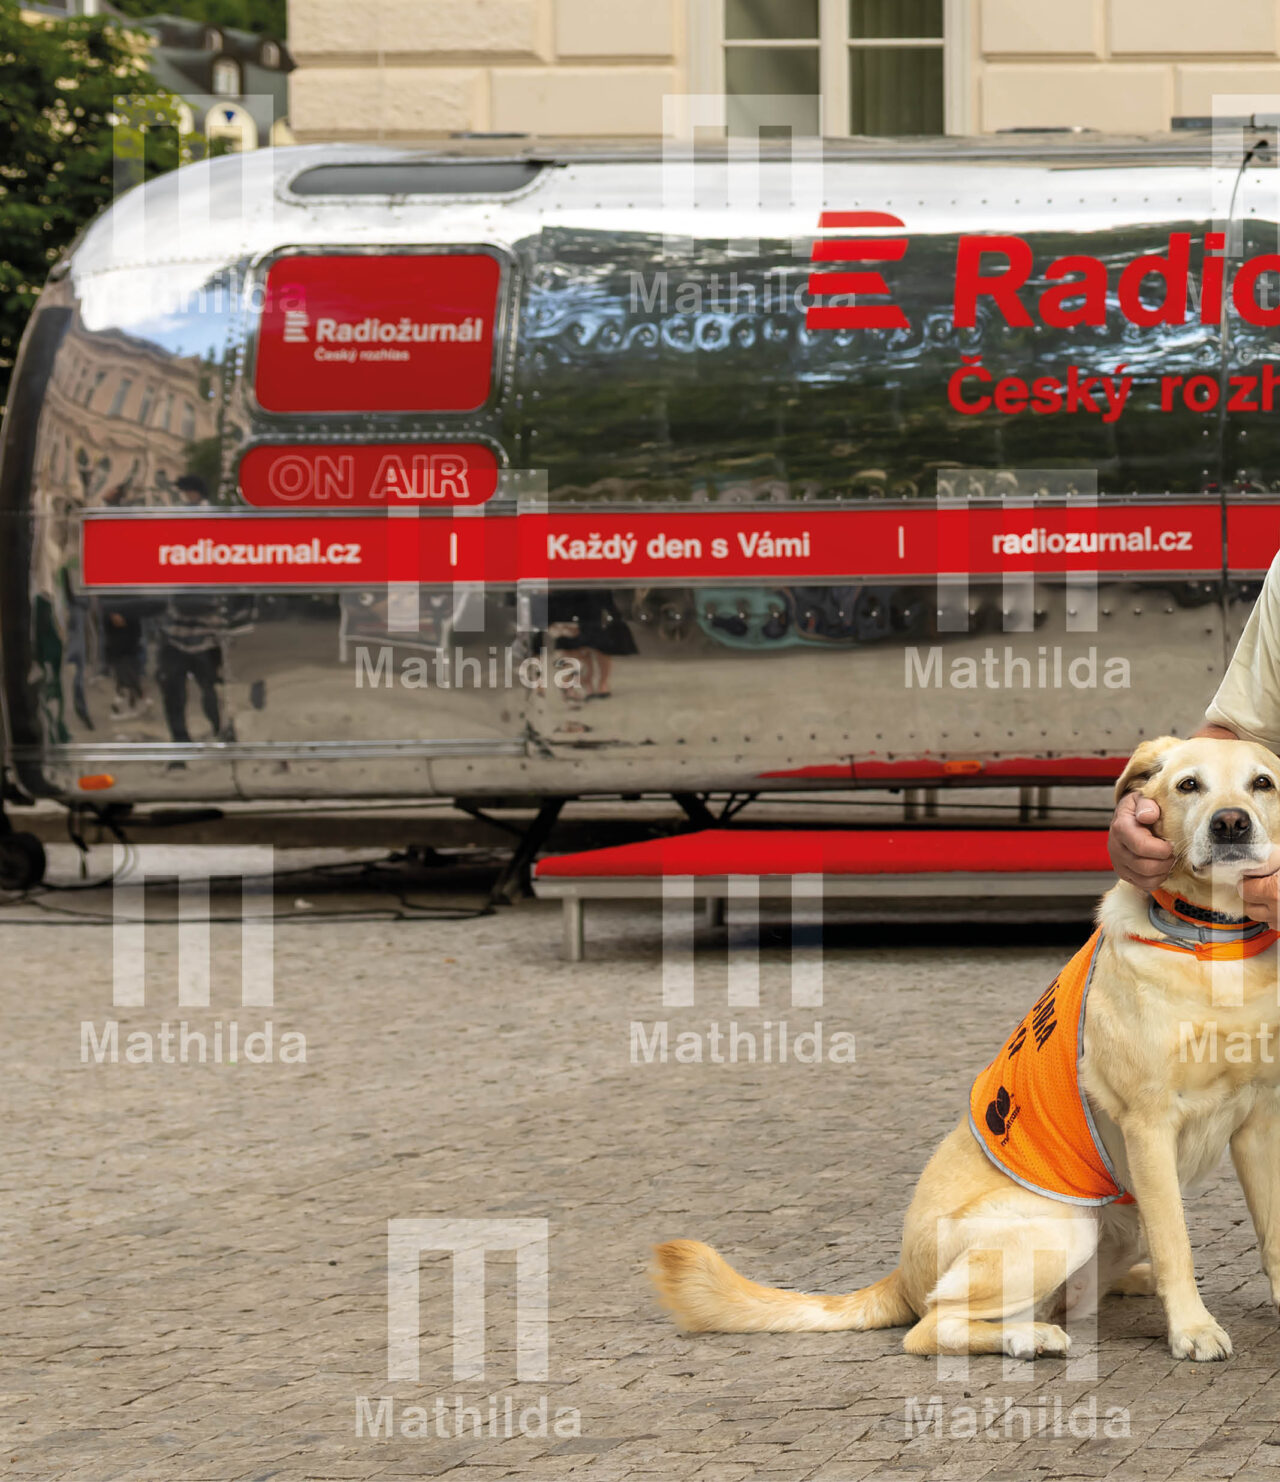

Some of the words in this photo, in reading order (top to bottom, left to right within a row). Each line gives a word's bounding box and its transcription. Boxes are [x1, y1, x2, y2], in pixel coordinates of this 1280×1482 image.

[316, 317, 483, 342] Radiožurnál
[314, 346, 357, 363] Český
[948, 354, 1134, 424] Český
[268, 454, 355, 500] ON
[369, 454, 470, 499] AIR
[159, 537, 362, 566] radiozurnal.cz
[547, 532, 638, 564] Každý
[647, 533, 702, 559] den
[711, 536, 728, 559] s
[737, 531, 811, 558] Vámi
[992, 526, 1193, 555] radiozurnal.cz
